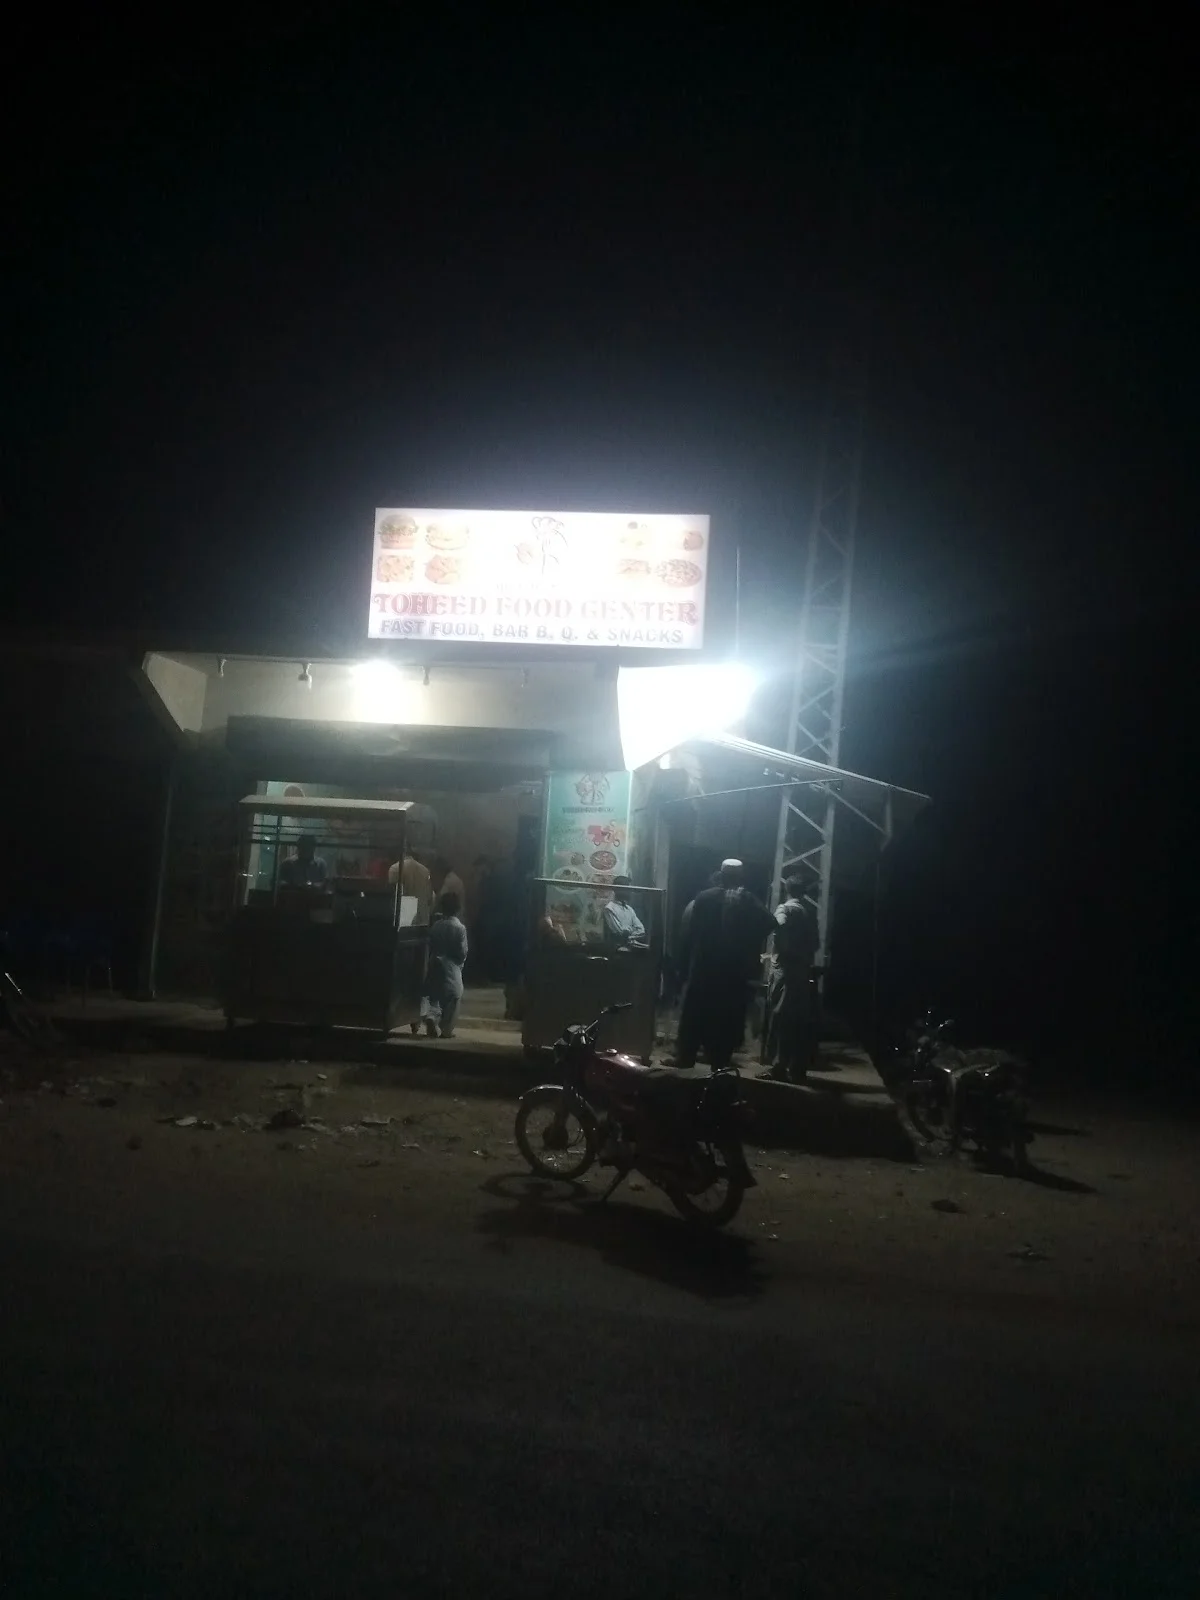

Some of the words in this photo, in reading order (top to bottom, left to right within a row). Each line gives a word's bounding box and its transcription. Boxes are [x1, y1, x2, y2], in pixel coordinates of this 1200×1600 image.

[372, 592, 487, 617] TOHEED
[496, 596, 573, 618] FOOD
[379, 618, 427, 634] FAST
[492, 623, 529, 638] BAR
[587, 628, 599, 641] &
[607, 627, 684, 644] SNACKS
